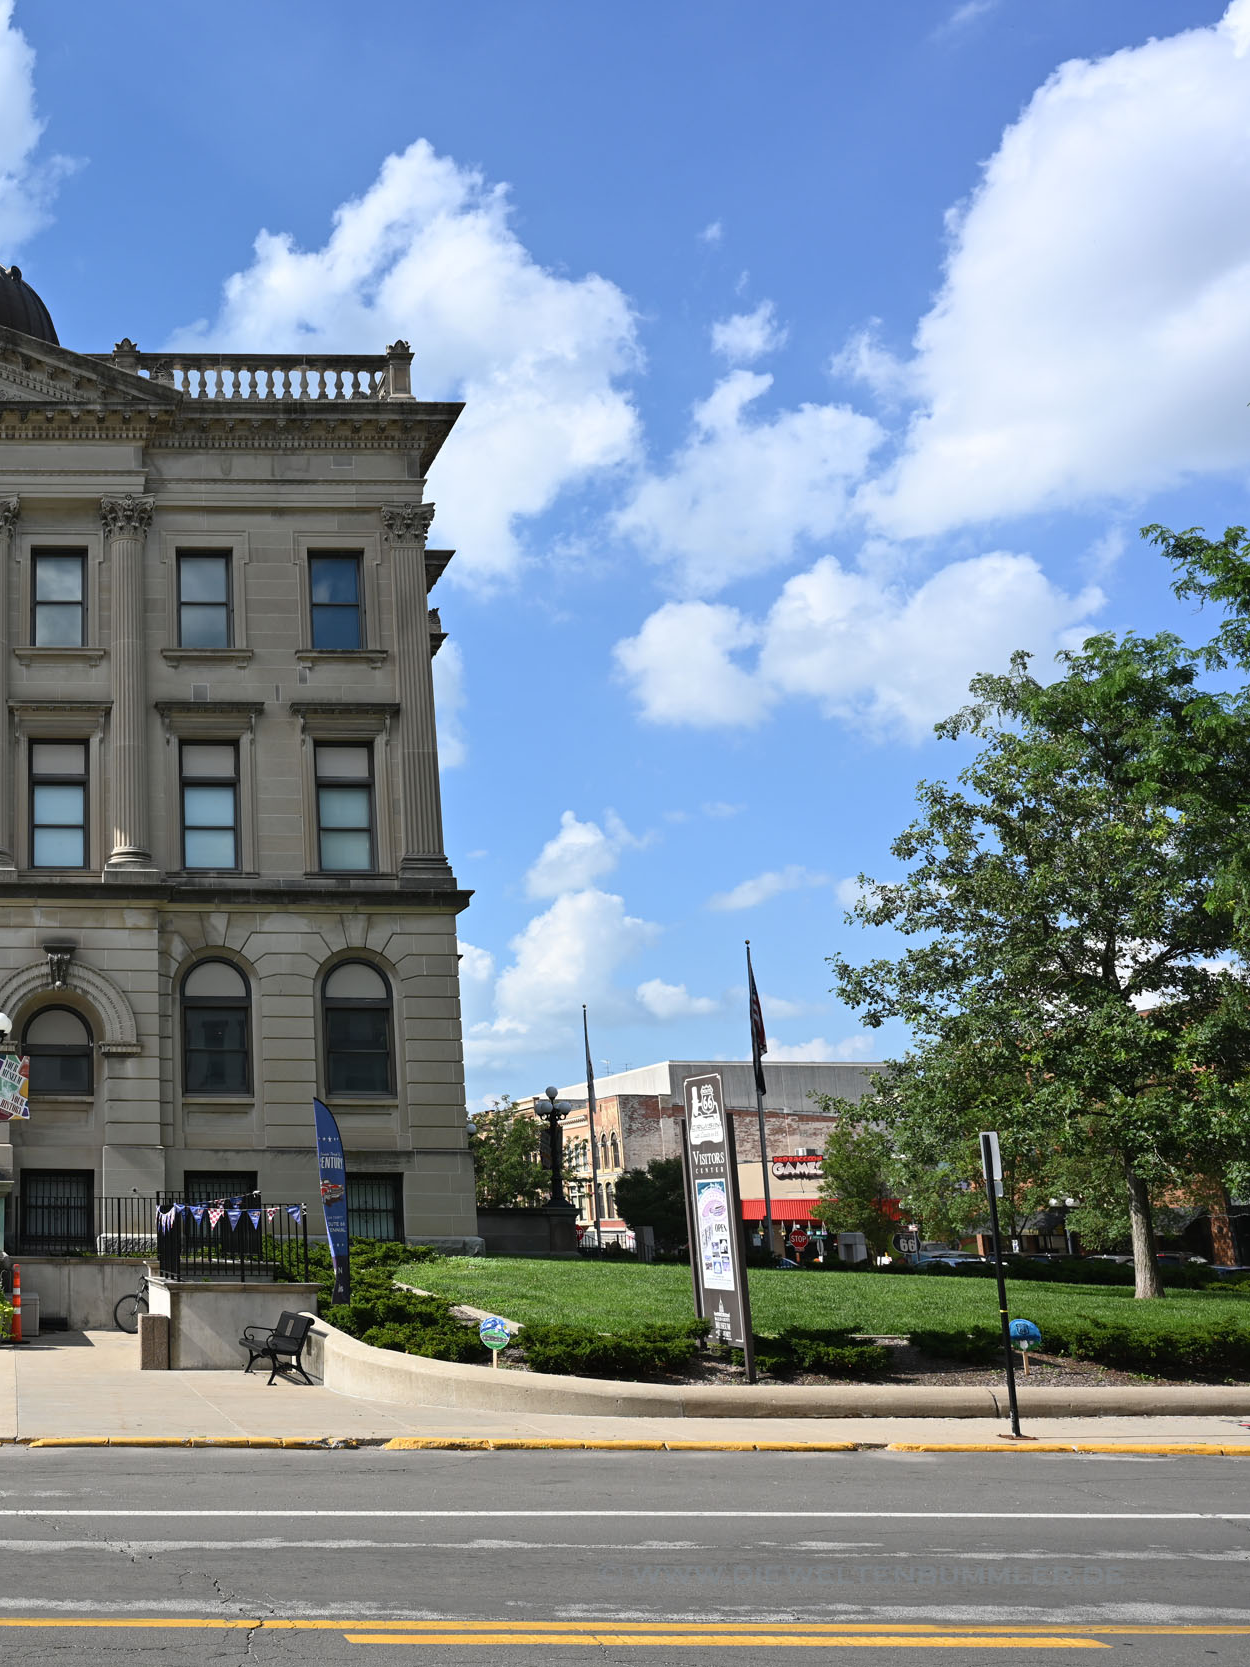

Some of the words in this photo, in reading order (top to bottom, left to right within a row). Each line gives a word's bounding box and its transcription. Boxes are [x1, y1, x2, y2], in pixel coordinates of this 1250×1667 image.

[703, 1095, 713, 1110] 66
[320, 1156, 343, 1170] ENTURY
[693, 1151, 725, 1166] VISITORS
[695, 1166, 724, 1175] CENTER
[790, 1235, 807, 1243] STOP
[900, 1238, 917, 1251] 66
